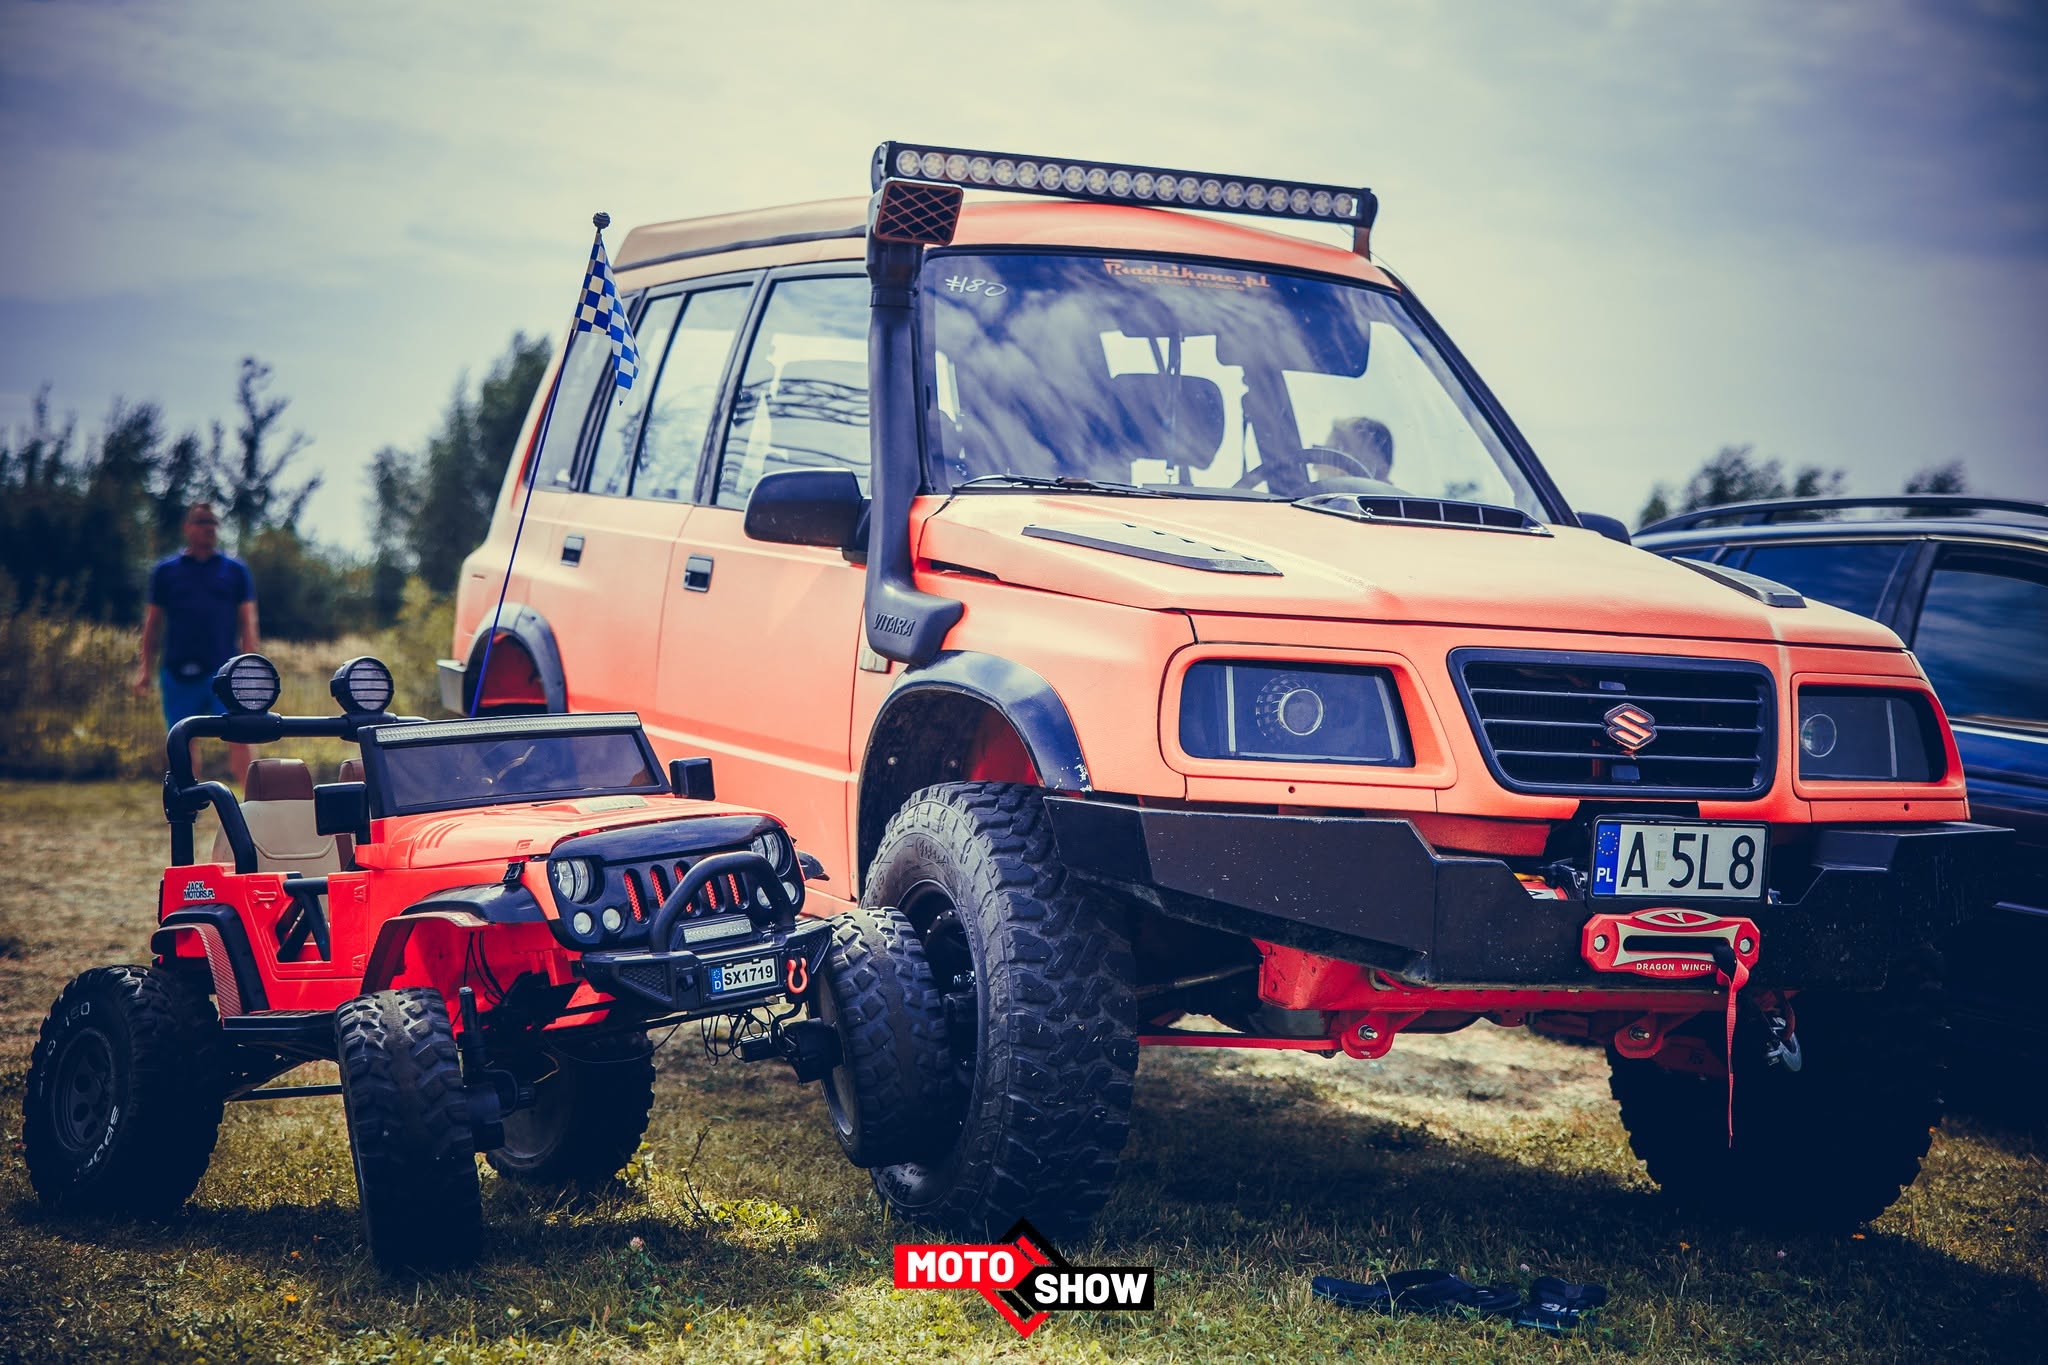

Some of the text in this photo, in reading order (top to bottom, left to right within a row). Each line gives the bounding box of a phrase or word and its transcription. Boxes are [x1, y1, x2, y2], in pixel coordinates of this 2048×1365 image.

[944, 275, 1007, 297] #180
[873, 613, 916, 637] VITARA
[1620, 832, 1756, 891] A 5L8
[1596, 867, 1613, 883] PL
[186, 881, 204, 891] JACK
[724, 965, 773, 986] SX1719
[1636, 963, 1712, 971] DRAGON WINCH
[714, 980, 722, 990] D
